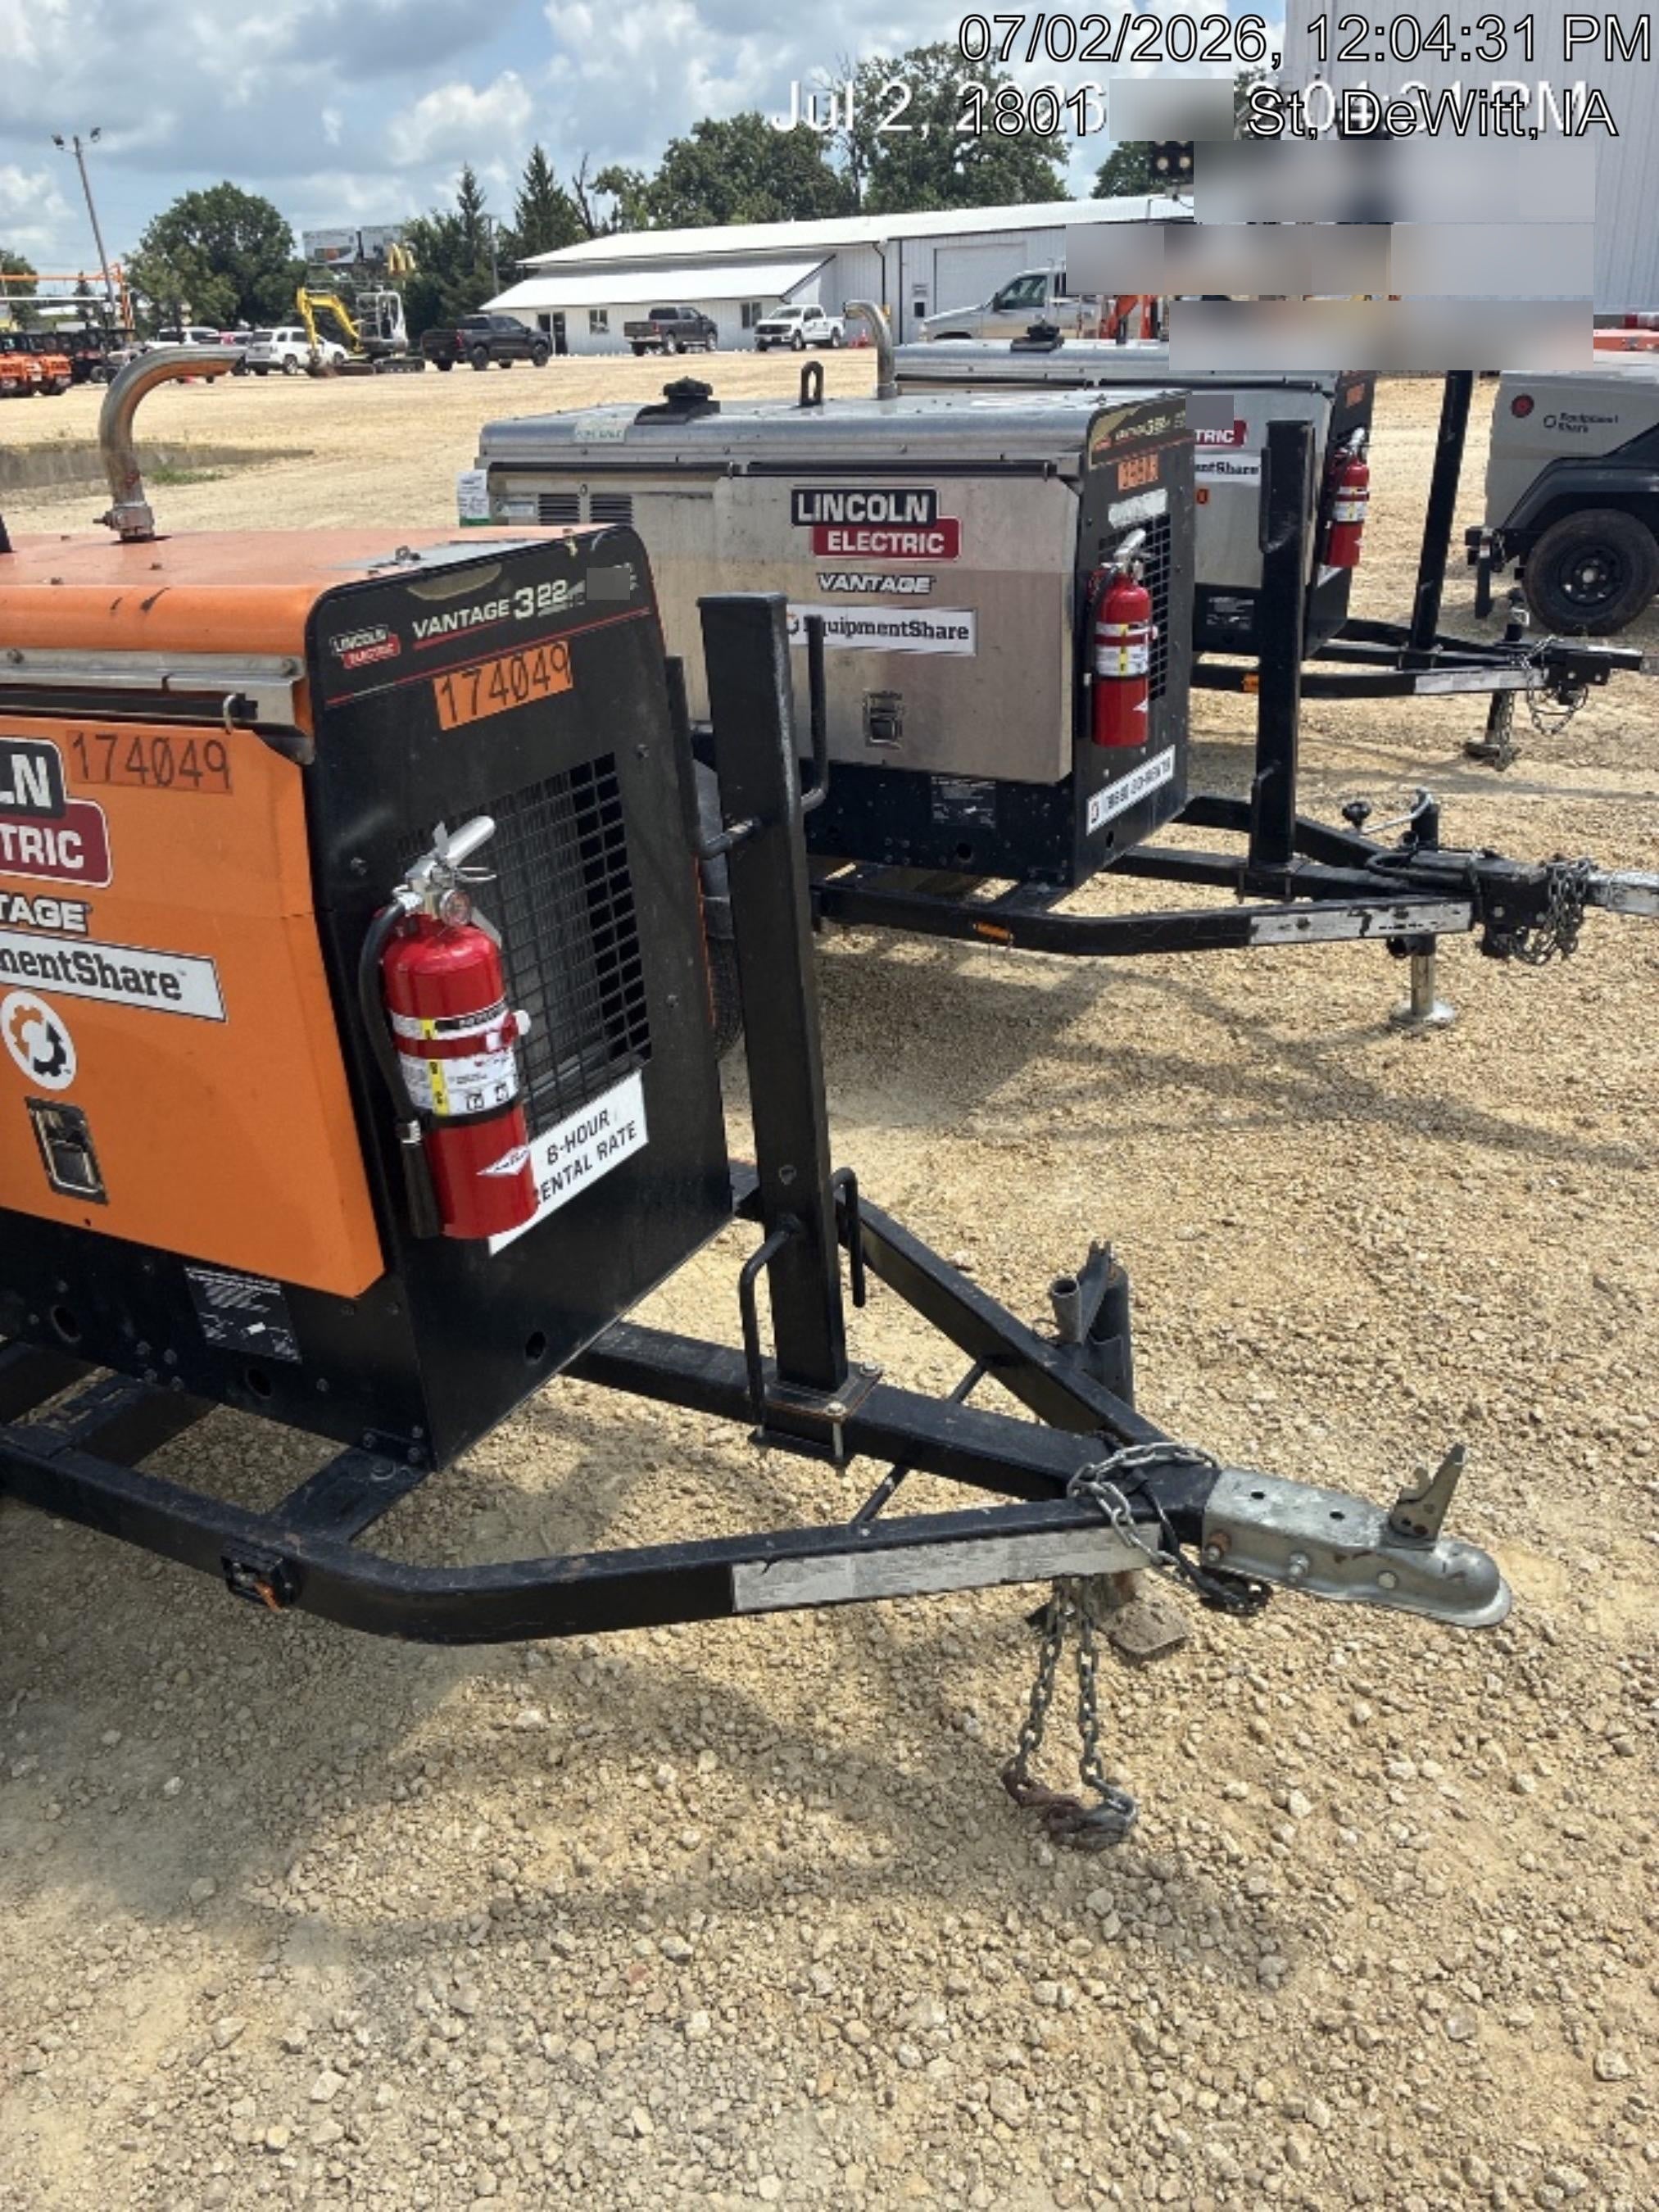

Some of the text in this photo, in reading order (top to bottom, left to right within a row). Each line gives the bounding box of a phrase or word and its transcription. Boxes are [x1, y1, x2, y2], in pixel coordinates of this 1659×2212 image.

[797, 493, 929, 523] LINCOLN
[827, 530, 945, 554] ELECTRIC
[818, 573, 932, 594] VANTAGE
[411, 579, 568, 641] VANTAGE 322
[804, 616, 969, 641] uipmentShare
[441, 642, 572, 723] 174049
[73, 732, 231, 790] 174049
[0, 825, 84, 869] TRIC
[546, 1108, 610, 1167] 8-HOUR
[533, 1154, 594, 1206] ENTAL
[596, 1121, 637, 1163] RATE
